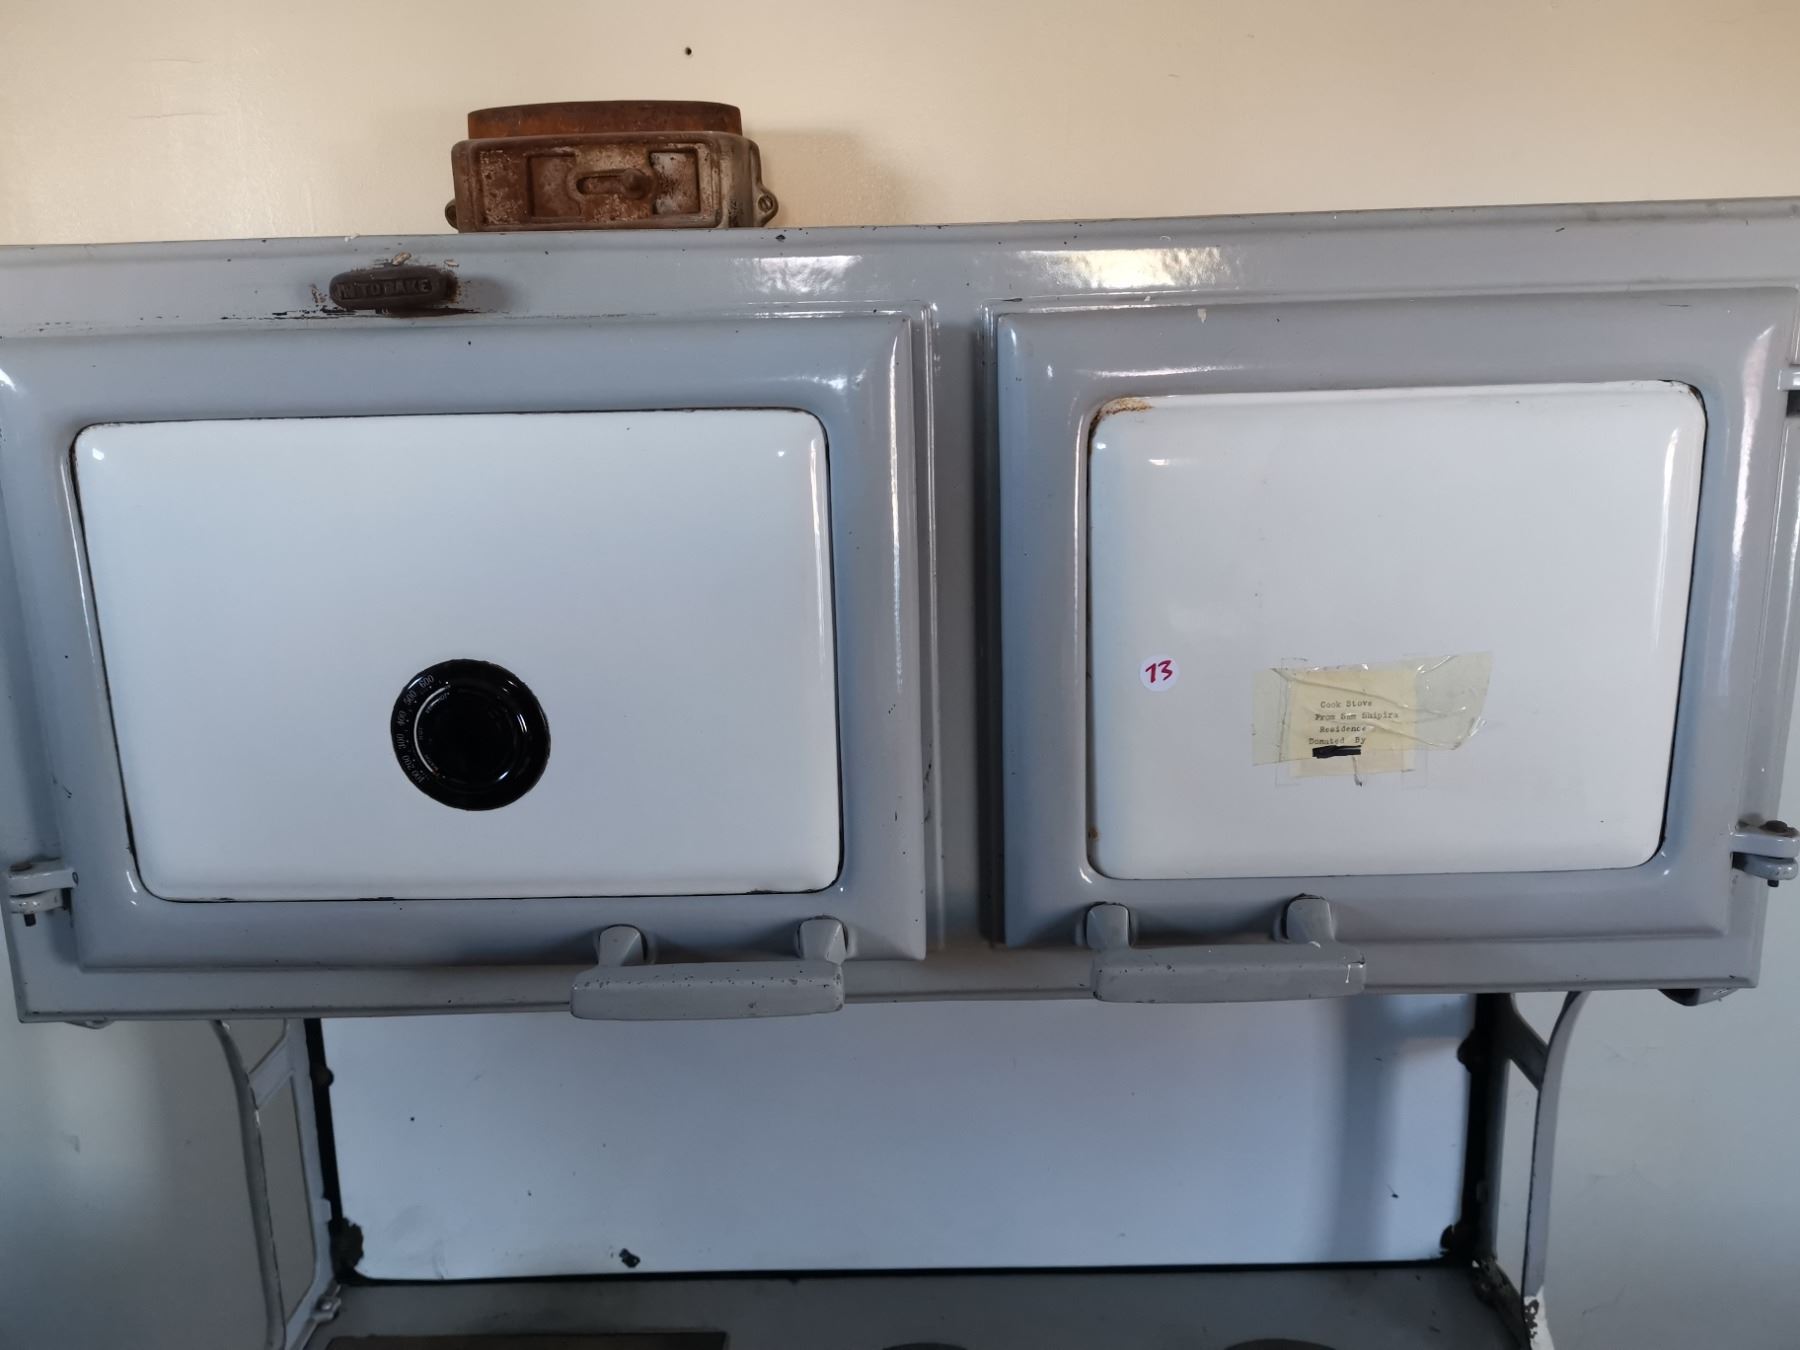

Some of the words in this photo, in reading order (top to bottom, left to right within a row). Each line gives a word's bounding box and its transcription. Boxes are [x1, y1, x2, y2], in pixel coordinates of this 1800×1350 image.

[1145, 659, 1173, 684] 13
[419, 674, 434, 688] 600
[1320, 701, 1342, 709] Cook
[1346, 700, 1373, 708] Stove
[1354, 736, 1366, 744] By
